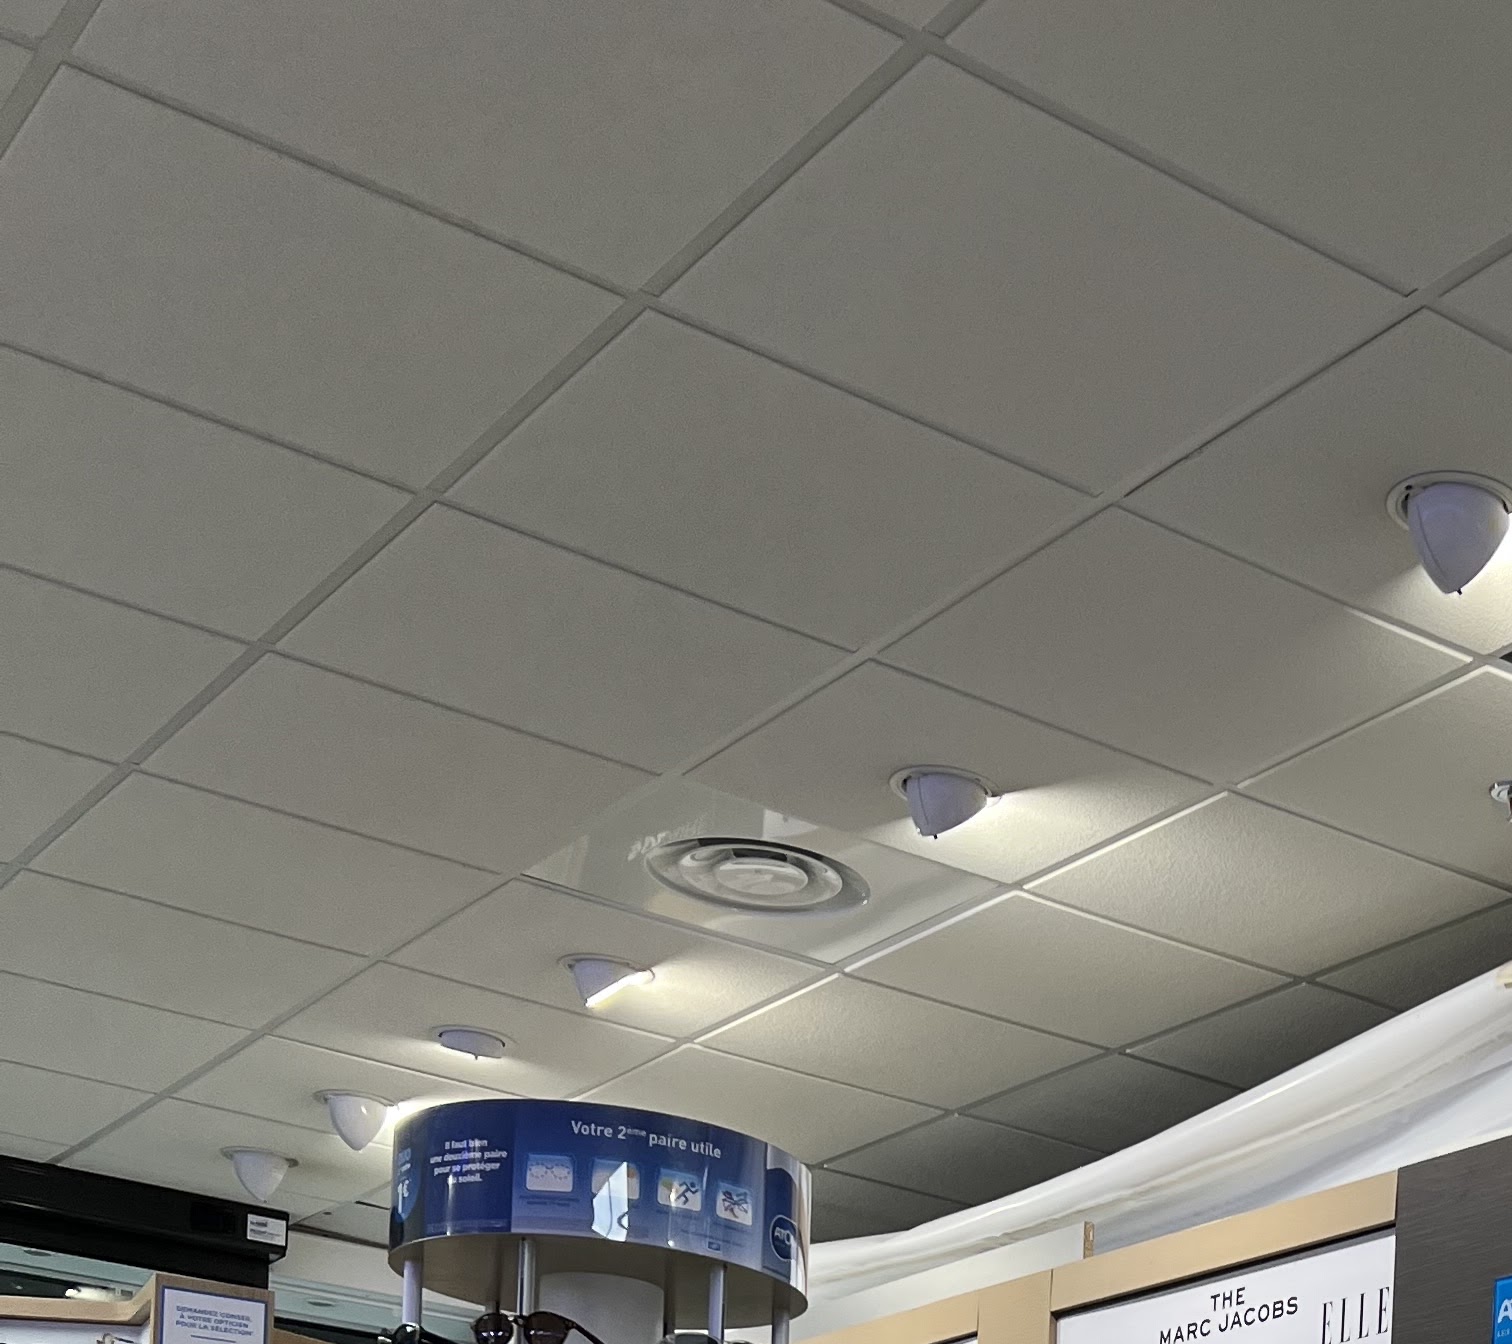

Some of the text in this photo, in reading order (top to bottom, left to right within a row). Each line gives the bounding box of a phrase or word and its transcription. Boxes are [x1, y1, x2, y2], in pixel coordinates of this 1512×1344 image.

[571, 1120, 613, 1138] Votre
[649, 1133, 687, 1151] paire
[691, 1139, 721, 1159] utile
[1210, 1286, 1246, 1312] THE
[1218, 1296, 1299, 1333] JACOBS
